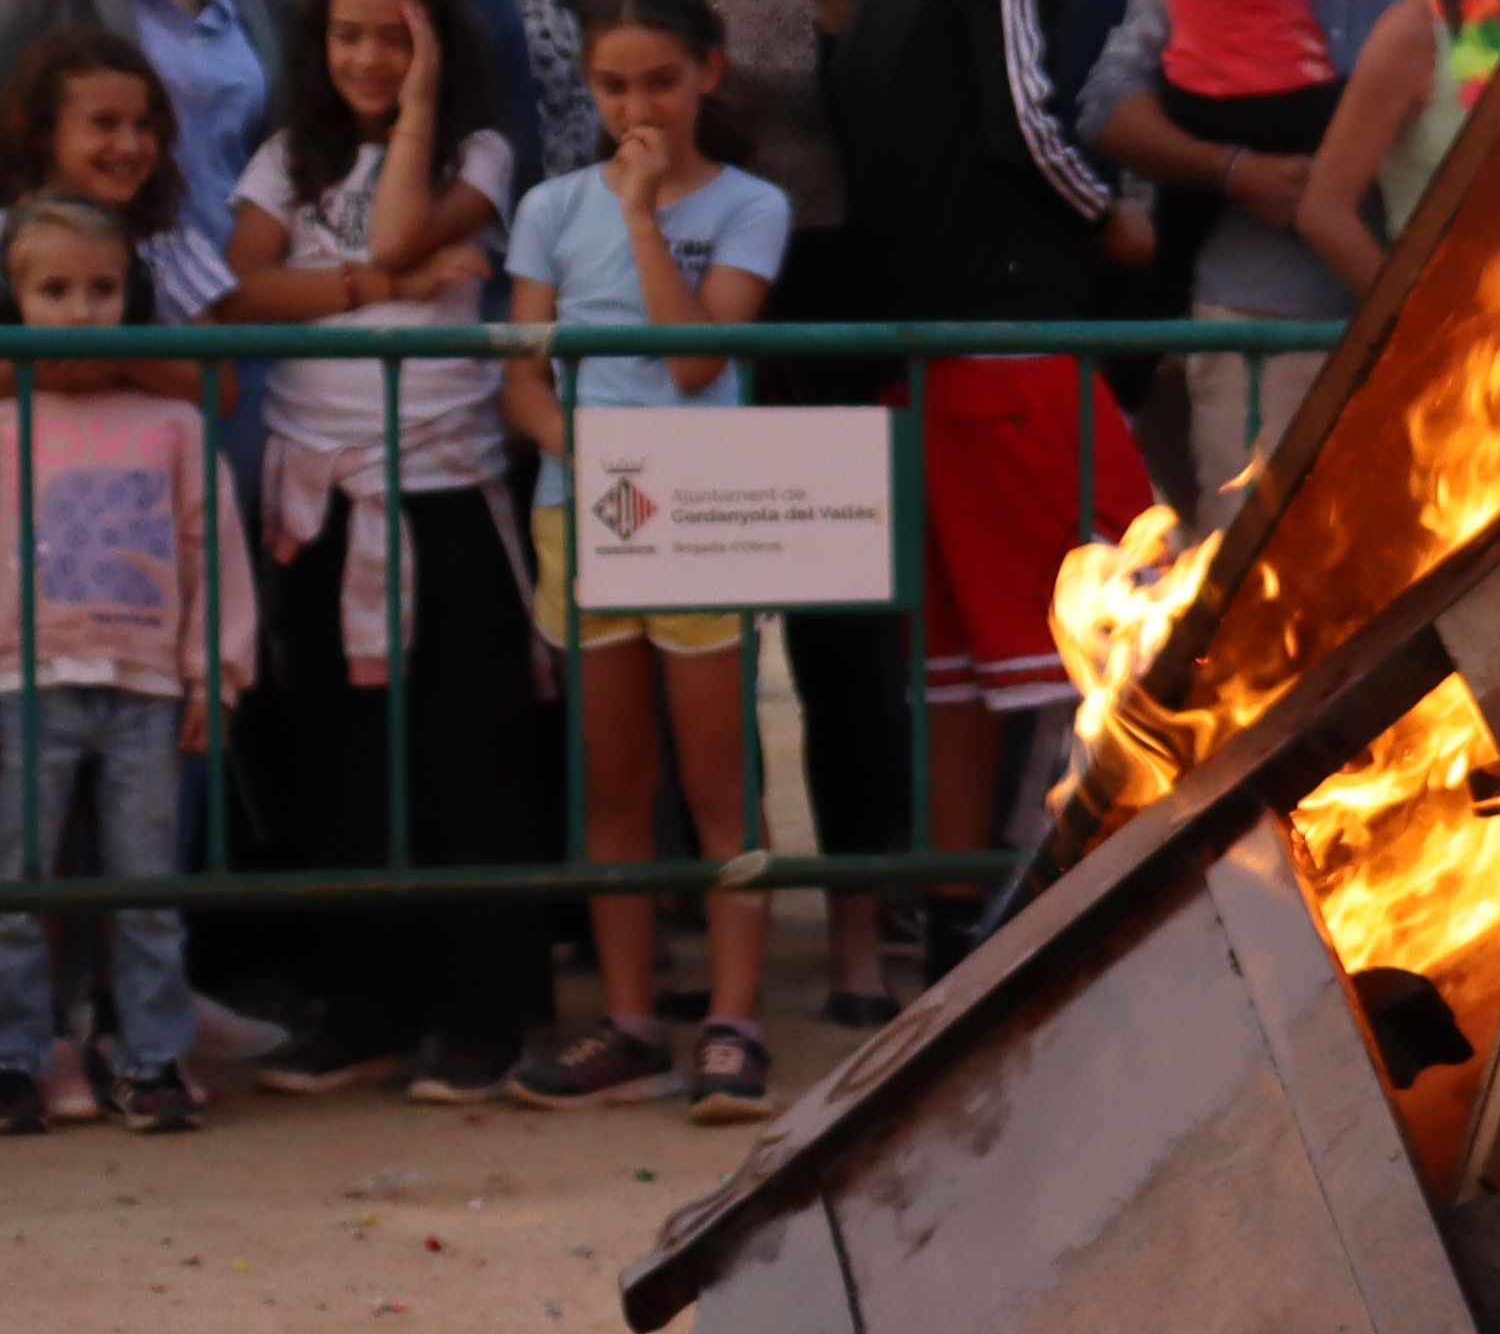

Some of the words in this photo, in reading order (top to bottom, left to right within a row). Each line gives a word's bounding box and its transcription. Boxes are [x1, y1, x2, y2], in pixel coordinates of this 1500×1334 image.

[671, 488, 775, 504] Ajuntament
[783, 487, 806, 501] de
[671, 507, 779, 525] Cerdanyola
[784, 506, 814, 520] del
